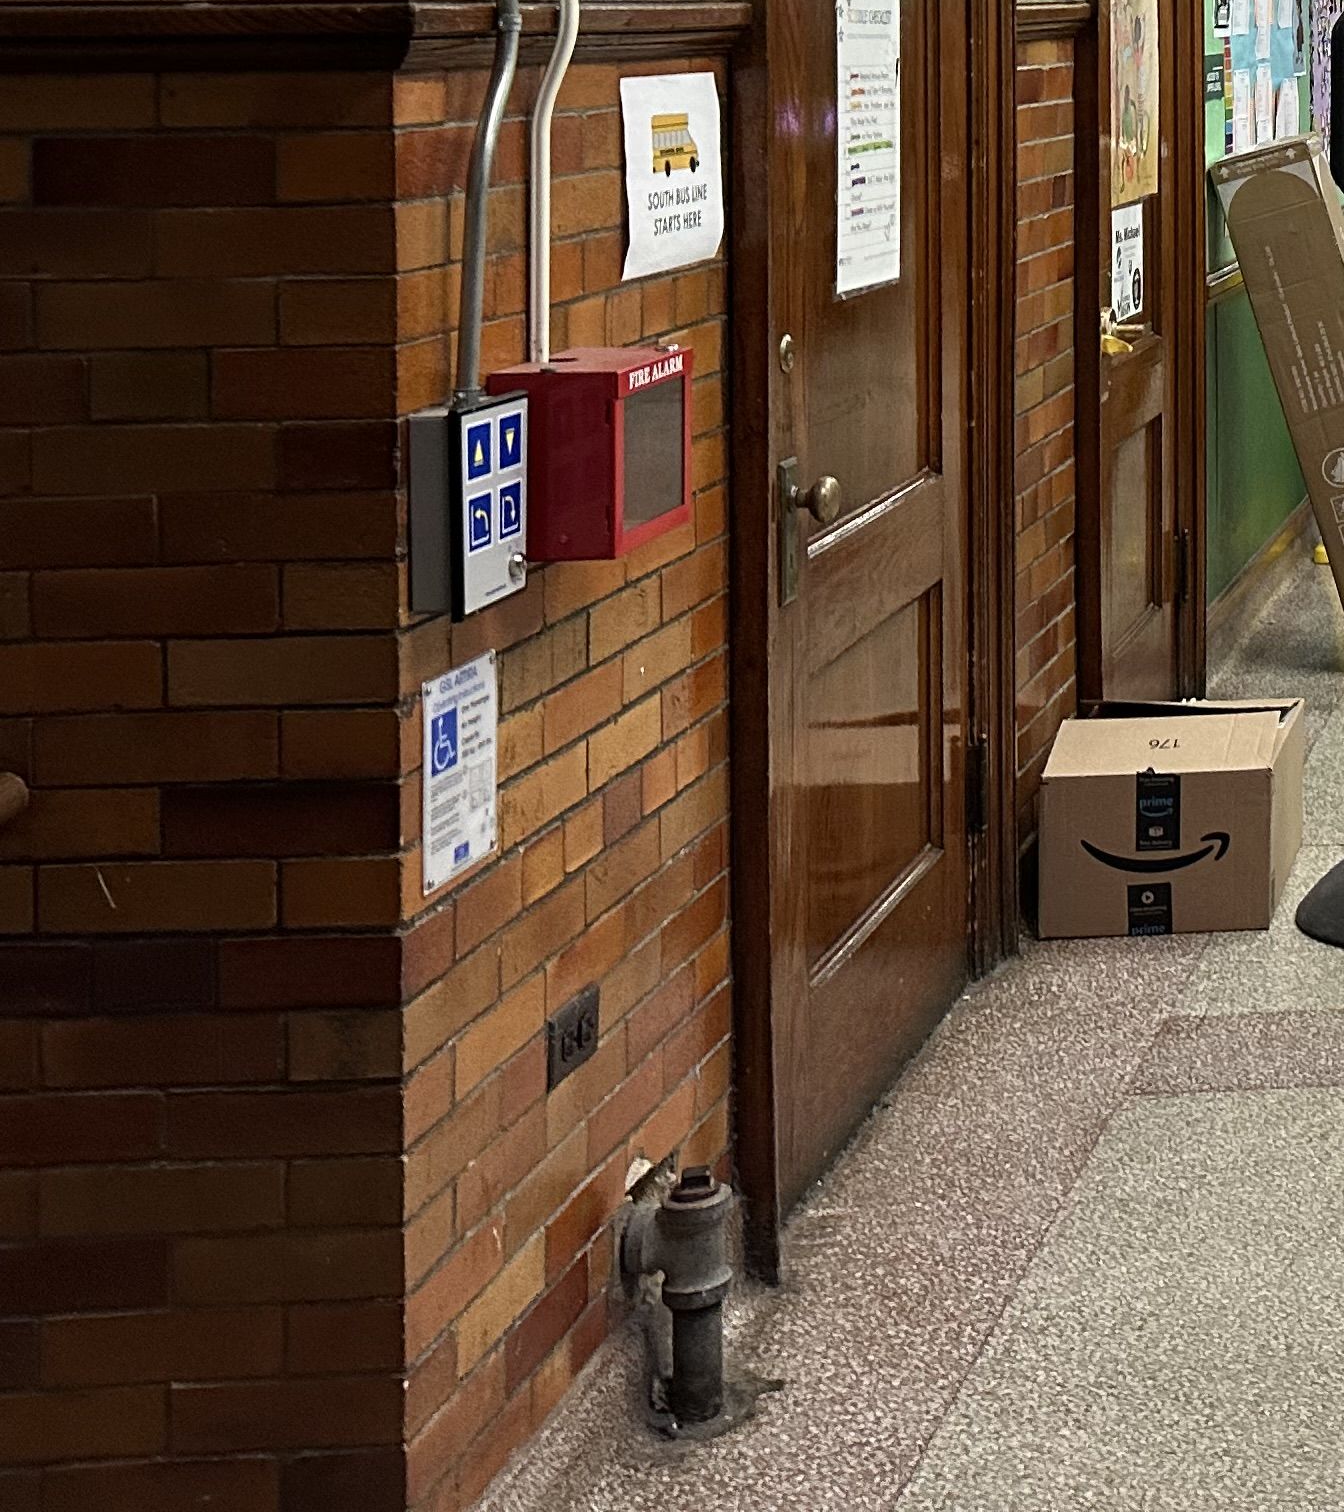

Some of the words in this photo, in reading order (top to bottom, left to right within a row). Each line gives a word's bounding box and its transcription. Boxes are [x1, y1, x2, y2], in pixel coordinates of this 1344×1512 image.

[648, 190, 674, 211] SOUTH
[676, 186, 690, 206] BUS
[692, 183, 708, 203] LINE
[654, 213, 681, 236] STARTS
[683, 210, 702, 230] HERE
[629, 366, 651, 390] FIRE
[651, 354, 683, 382] ALARM
[1149, 739, 1180, 749] 176
[1140, 796, 1174, 810] prime
